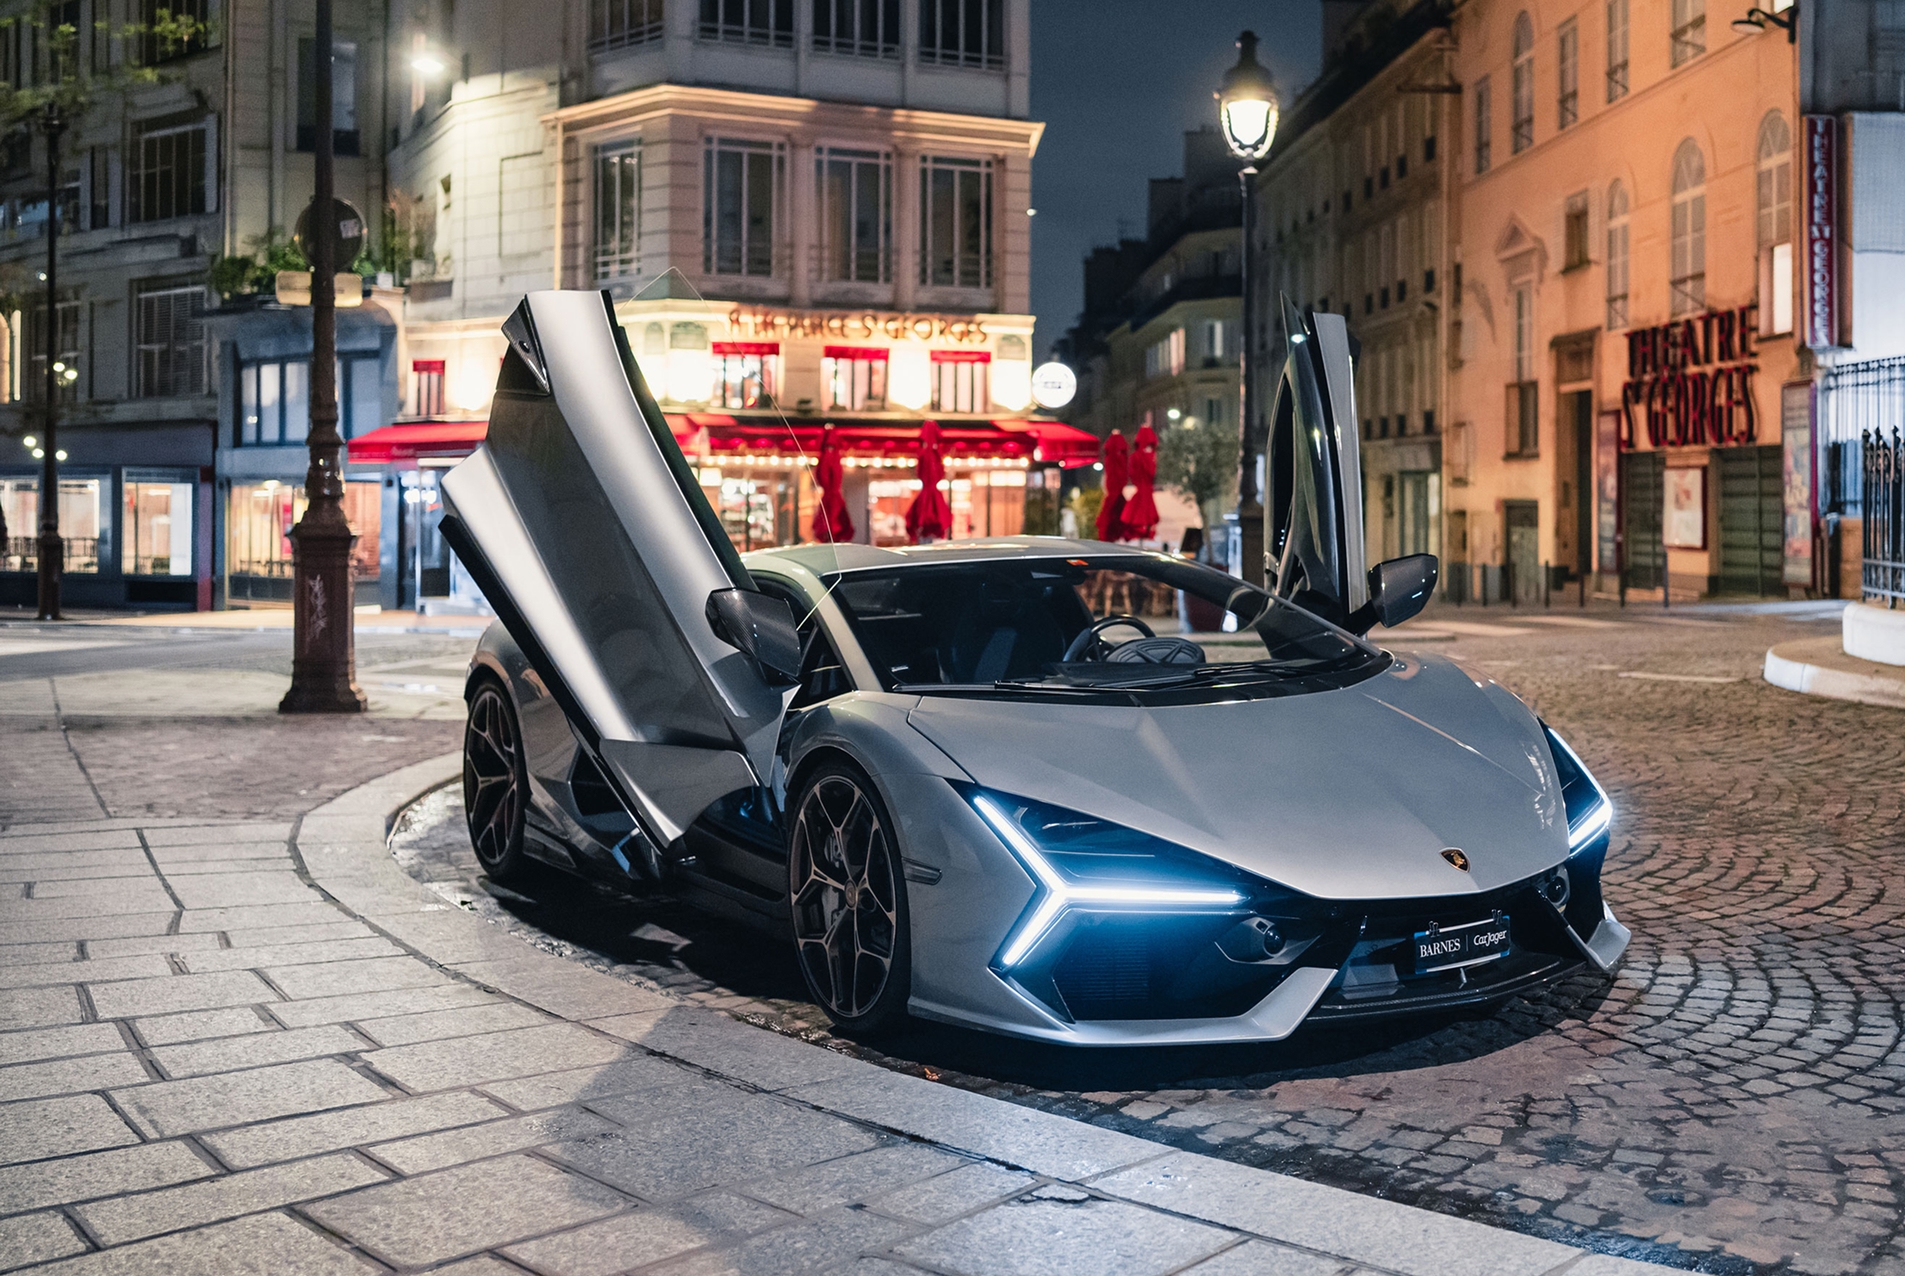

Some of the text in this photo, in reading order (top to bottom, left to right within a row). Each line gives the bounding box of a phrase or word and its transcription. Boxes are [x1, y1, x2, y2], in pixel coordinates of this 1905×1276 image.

[1624, 306, 1758, 379] THEATRE
[1647, 365, 1760, 448] GEORGES
[1419, 930, 1508, 958] BARNES CarJager
